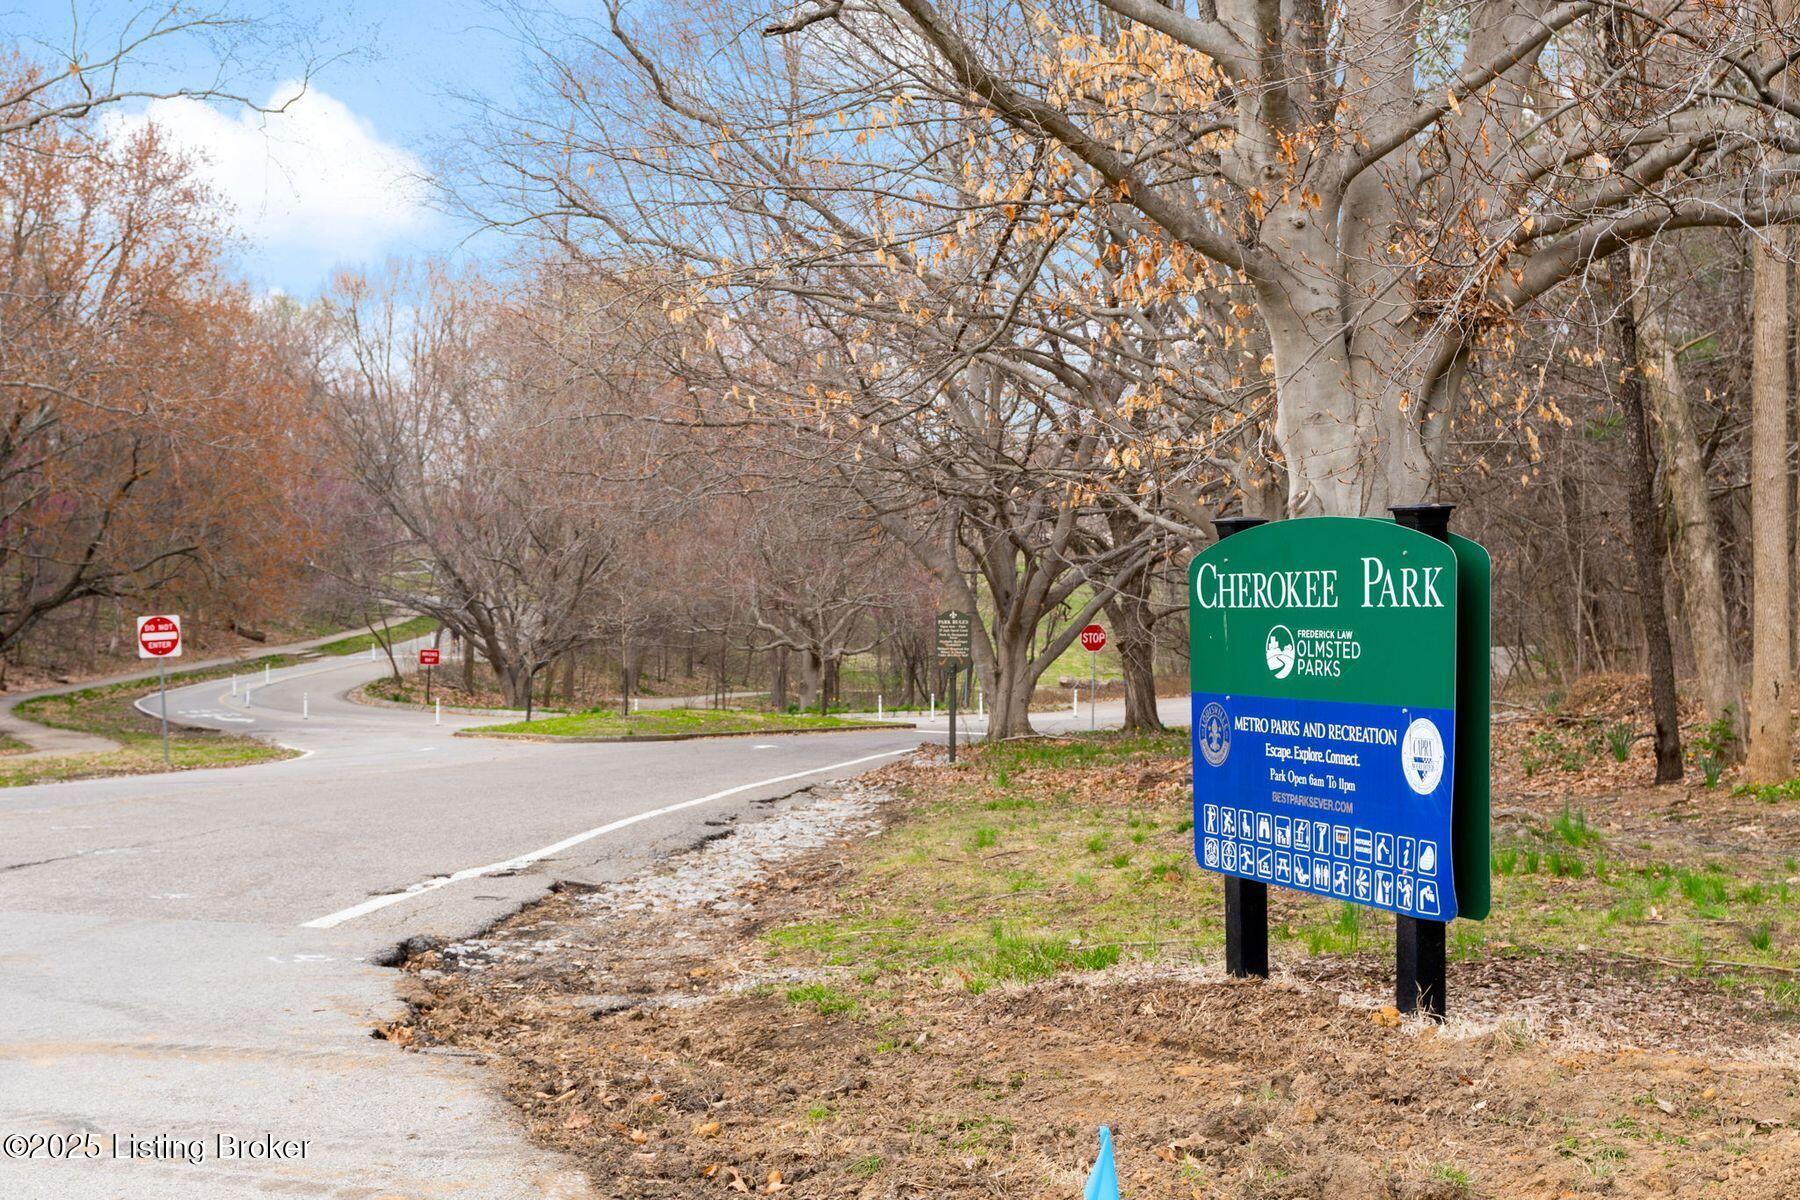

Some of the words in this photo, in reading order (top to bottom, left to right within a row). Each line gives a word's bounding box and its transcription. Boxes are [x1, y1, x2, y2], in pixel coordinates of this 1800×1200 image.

[1196, 562, 1339, 609] CHEROKEE
[1361, 557, 1445, 609] PARK
[144, 624, 155, 632] DO
[158, 623, 173, 631] NOT
[1297, 629, 1335, 640] FREDERICK
[1337, 631, 1353, 640] LAW
[148, 641, 172, 650] ENTER
[1082, 632, 1106, 644] STOP
[1297, 640, 1361, 660] OLMSTED
[1297, 659, 1341, 678] PARKS
[1234, 716, 1268, 734] METRO
[1270, 718, 1300, 736] PARKS
[1303, 722, 1326, 739] AND
[1328, 724, 1398, 746] RECREATION
[1265, 743, 1293, 762] Escape.
[1294, 746, 1324, 764] Explore.
[1326, 750, 1360, 767] Connect.
[1270, 768, 1286, 782] Park
[1288, 770, 1307, 787] Open
[1308, 774, 1324, 788] 6am
[1326, 775, 1336, 789] To
[1272, 790, 1354, 814] BESTPARKSEVER.COM
